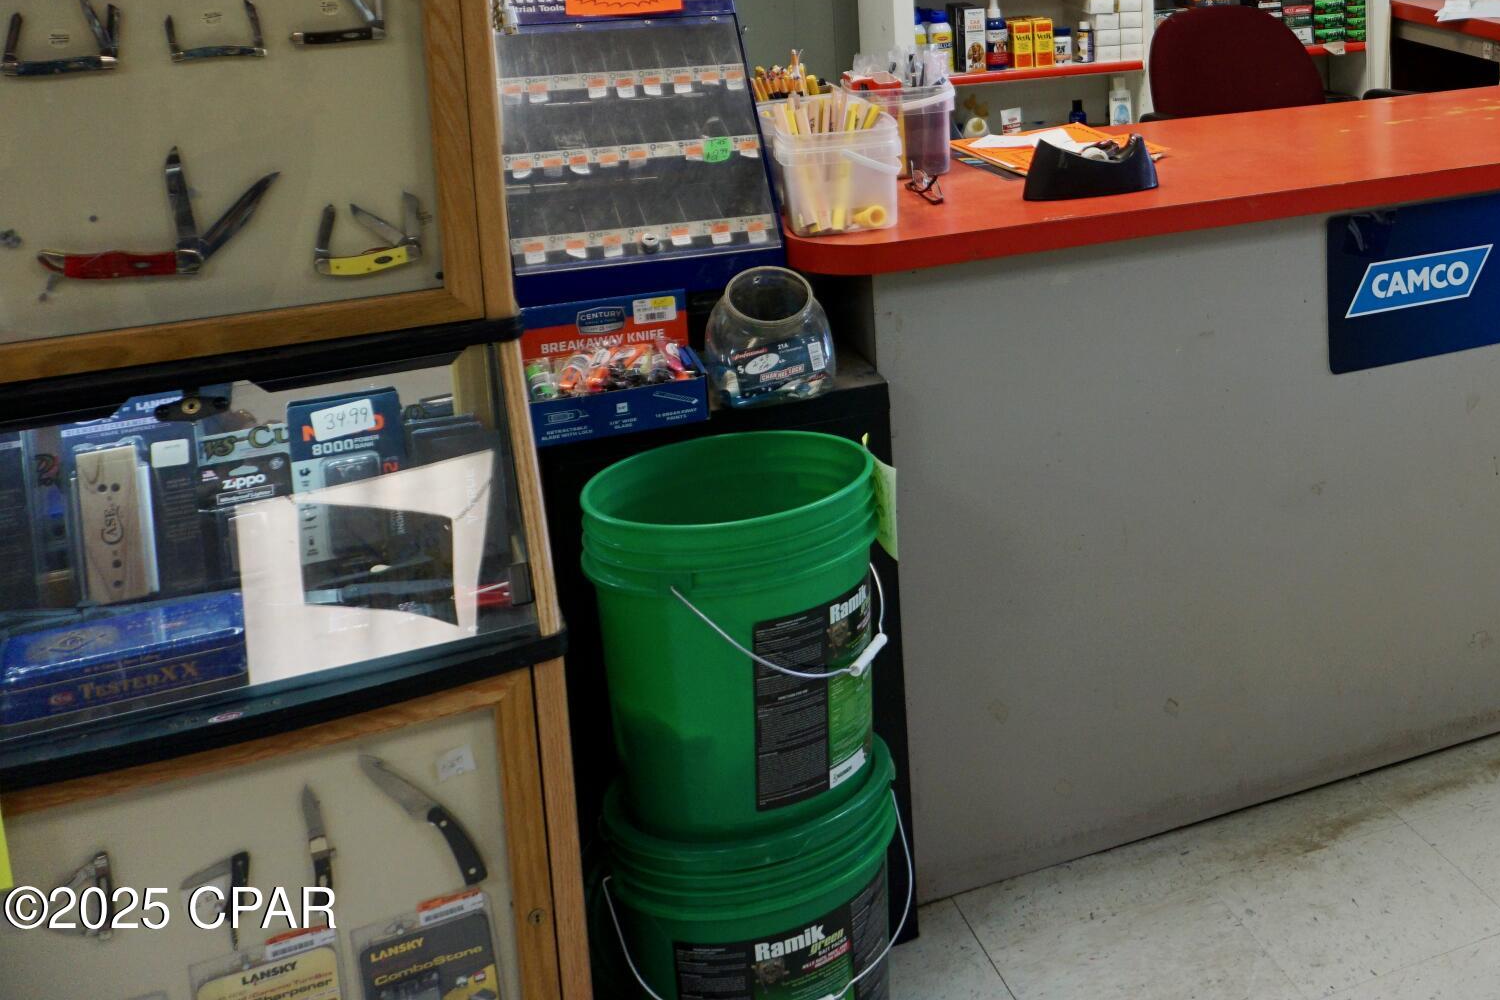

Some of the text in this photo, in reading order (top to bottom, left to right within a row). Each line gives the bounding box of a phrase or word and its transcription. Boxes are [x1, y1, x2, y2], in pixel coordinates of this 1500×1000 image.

[538, 4, 565, 12] Tools
[1371, 260, 1470, 300] CAMCO
[580, 310, 623, 321] CENTURY
[541, 329, 665, 354] BREAKAWAY KNIFE
[323, 407, 370, 430] 34.99
[312, 440, 354, 456] 8000
[353, 435, 380, 443] POWER
[353, 441, 375, 449] BANK
[221, 473, 266, 490] zippo
[101, 504, 124, 545] CASE
[829, 584, 868, 625] Ramik
[370, 937, 425, 963] LANSKY
[754, 924, 826, 962] Ramik
[808, 928, 845, 957] green
[241, 961, 298, 986] LANSKY
[374, 944, 484, 986] ComboStone
